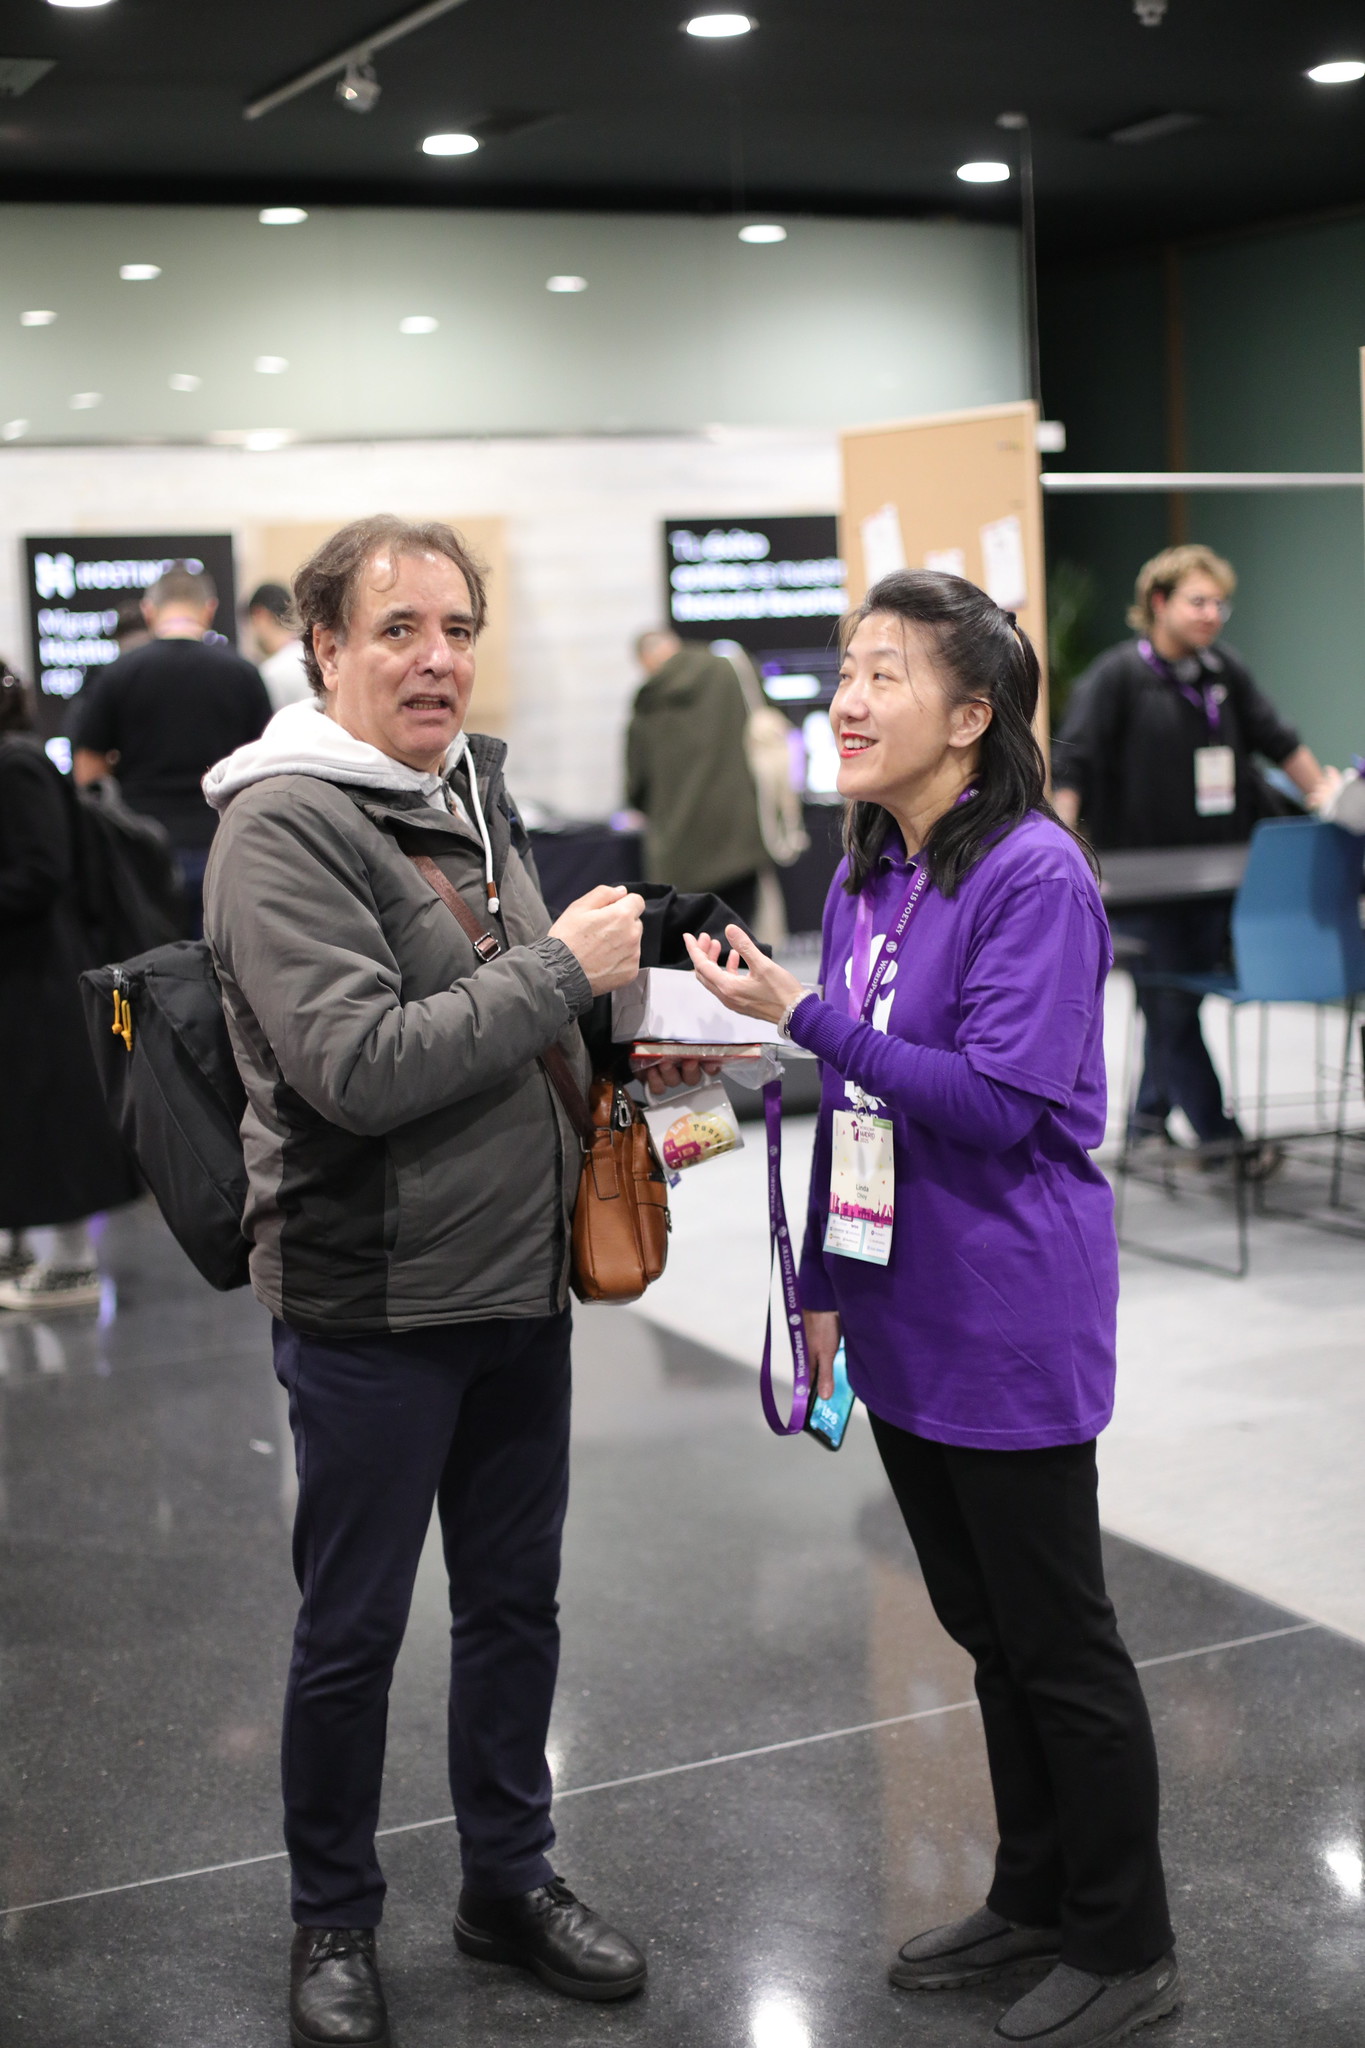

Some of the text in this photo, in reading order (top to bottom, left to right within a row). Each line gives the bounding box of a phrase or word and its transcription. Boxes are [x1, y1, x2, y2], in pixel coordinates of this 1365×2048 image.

[910, 892, 919, 901] IS
[895, 901, 914, 936] POETRY
[856, 1184, 869, 1192] Linda
[782, 1245, 796, 1309] CODE IS POETRY
